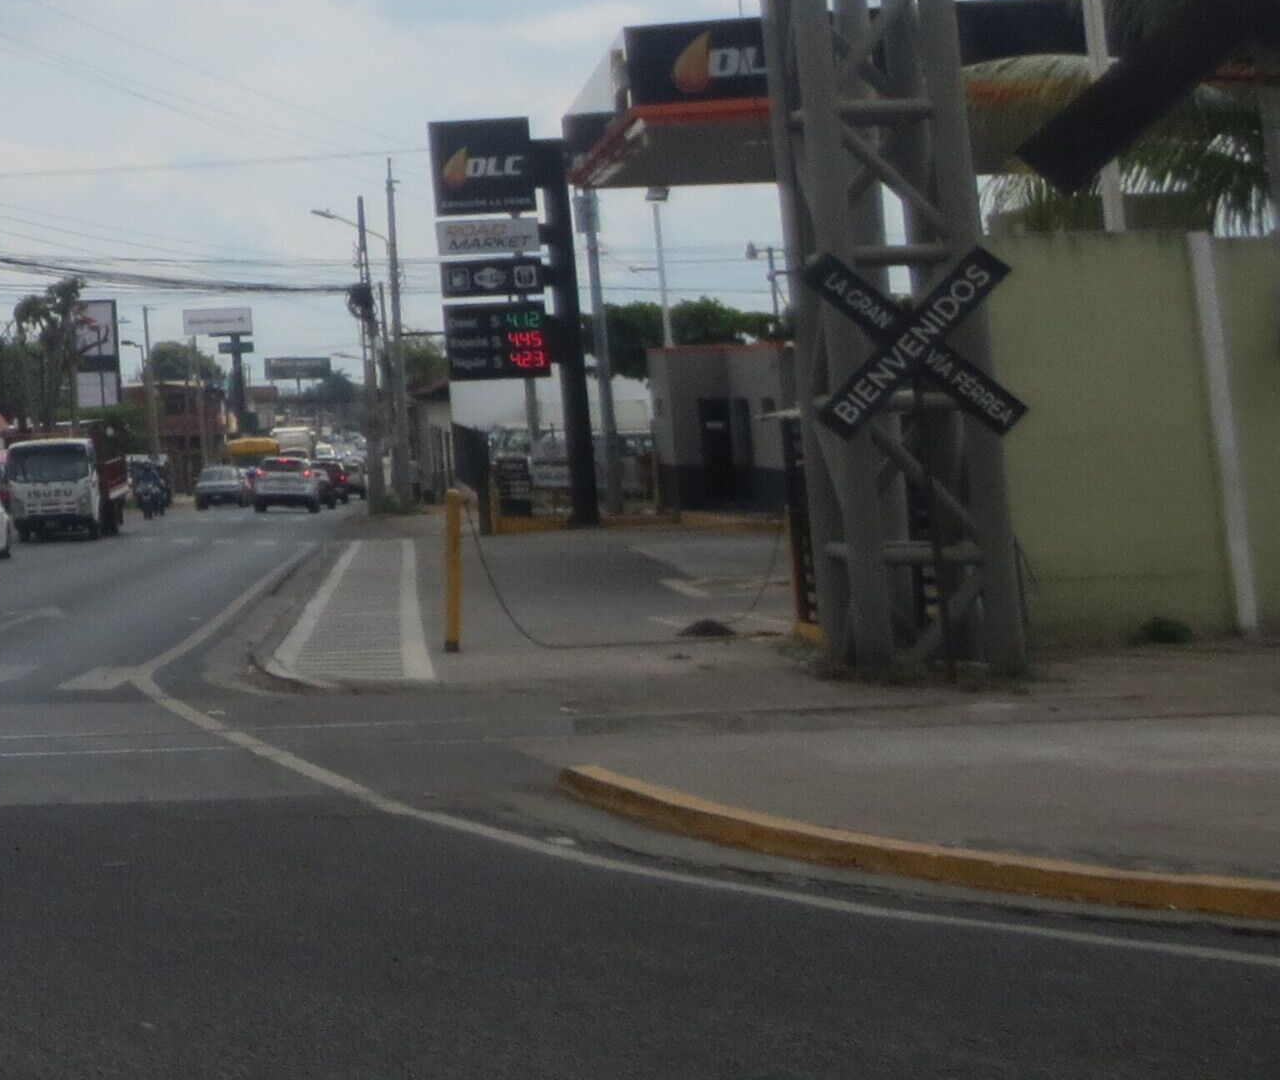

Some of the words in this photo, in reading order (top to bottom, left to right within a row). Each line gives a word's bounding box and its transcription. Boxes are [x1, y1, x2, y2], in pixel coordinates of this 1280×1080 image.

[466, 155, 524, 178] DLC
[449, 235, 530, 251] MARKET
[823, 272, 849, 296] LA
[846, 288, 893, 330] GRAN
[833, 263, 991, 425] BIENVENIDOS
[26, 488, 74, 498] ISUZU
